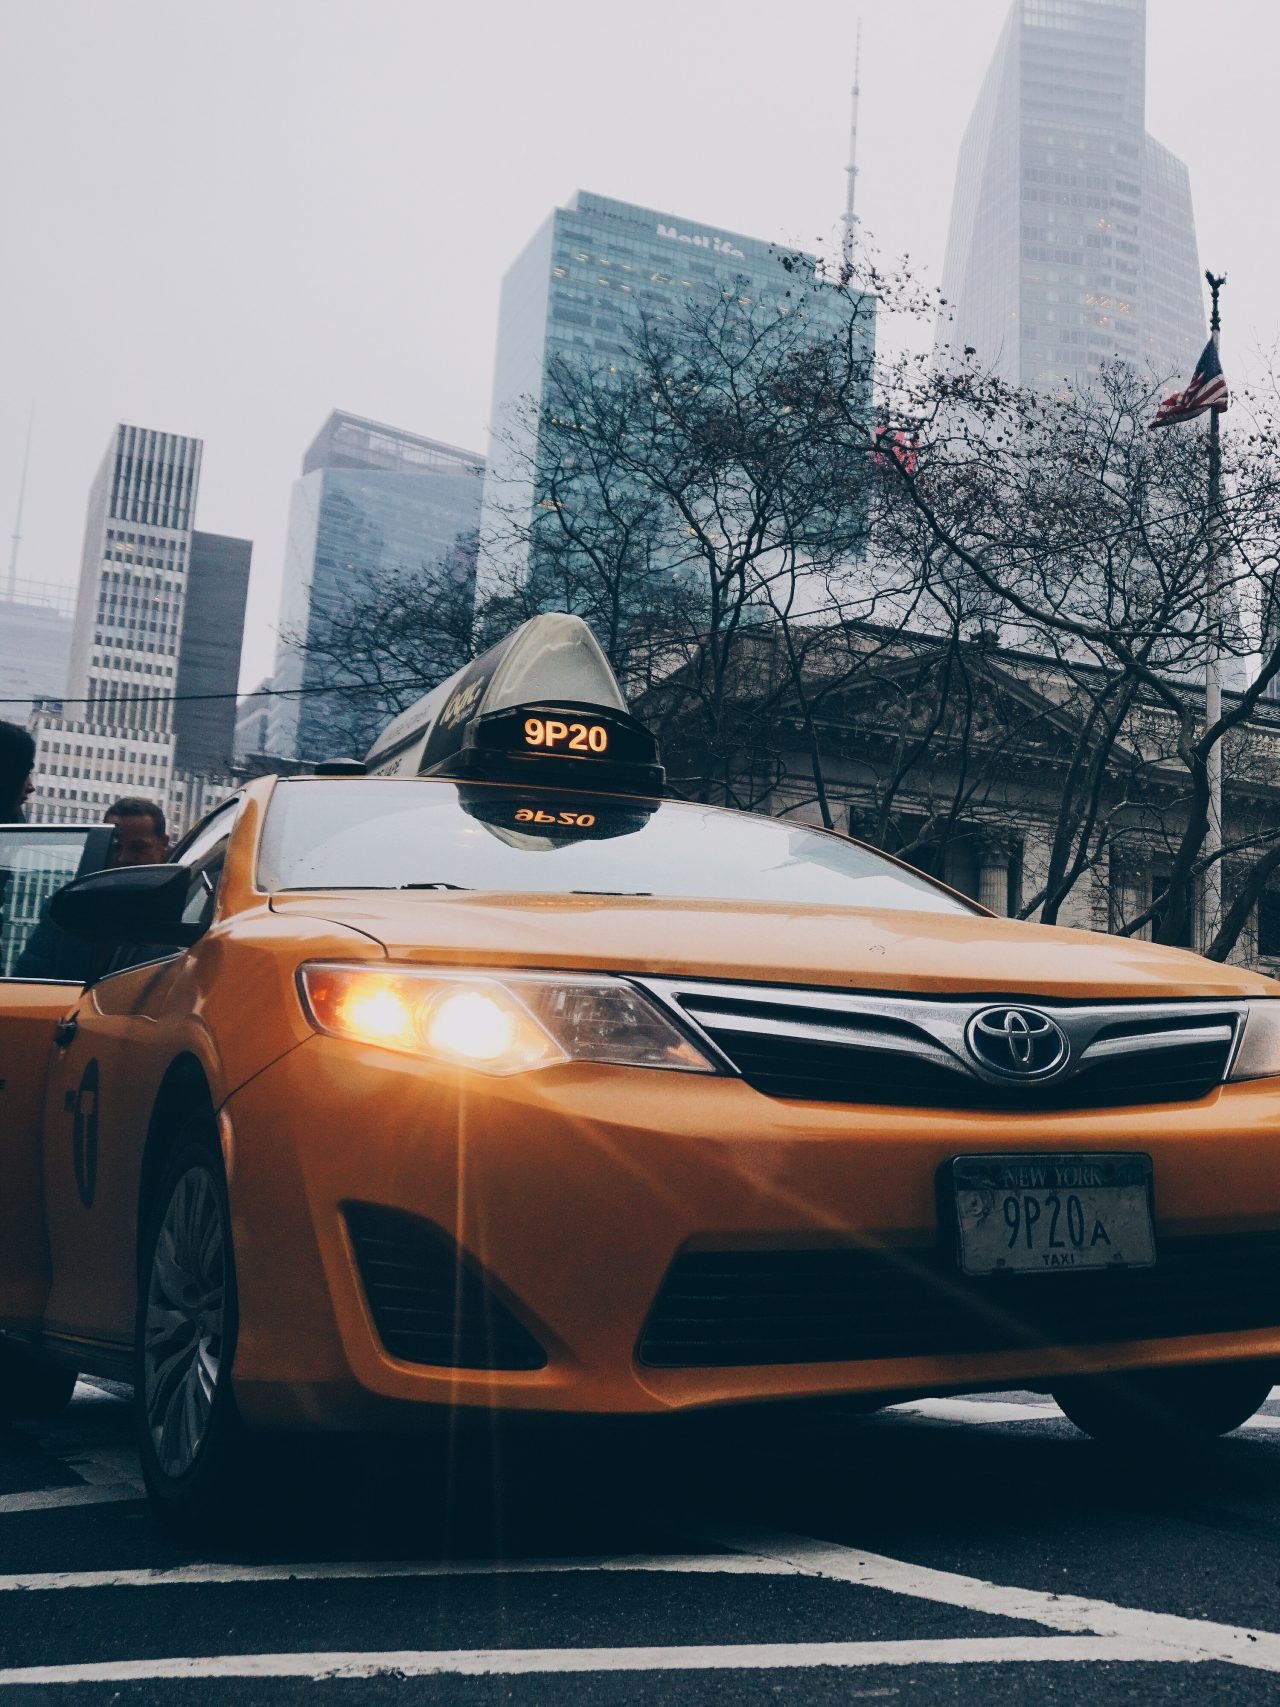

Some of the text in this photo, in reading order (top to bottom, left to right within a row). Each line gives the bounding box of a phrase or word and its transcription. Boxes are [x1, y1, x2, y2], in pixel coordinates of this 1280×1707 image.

[524, 718, 608, 752] 9P20
[1004, 1167, 1103, 1187] NEW YORK
[1042, 1254, 1075, 1266] TAXI
